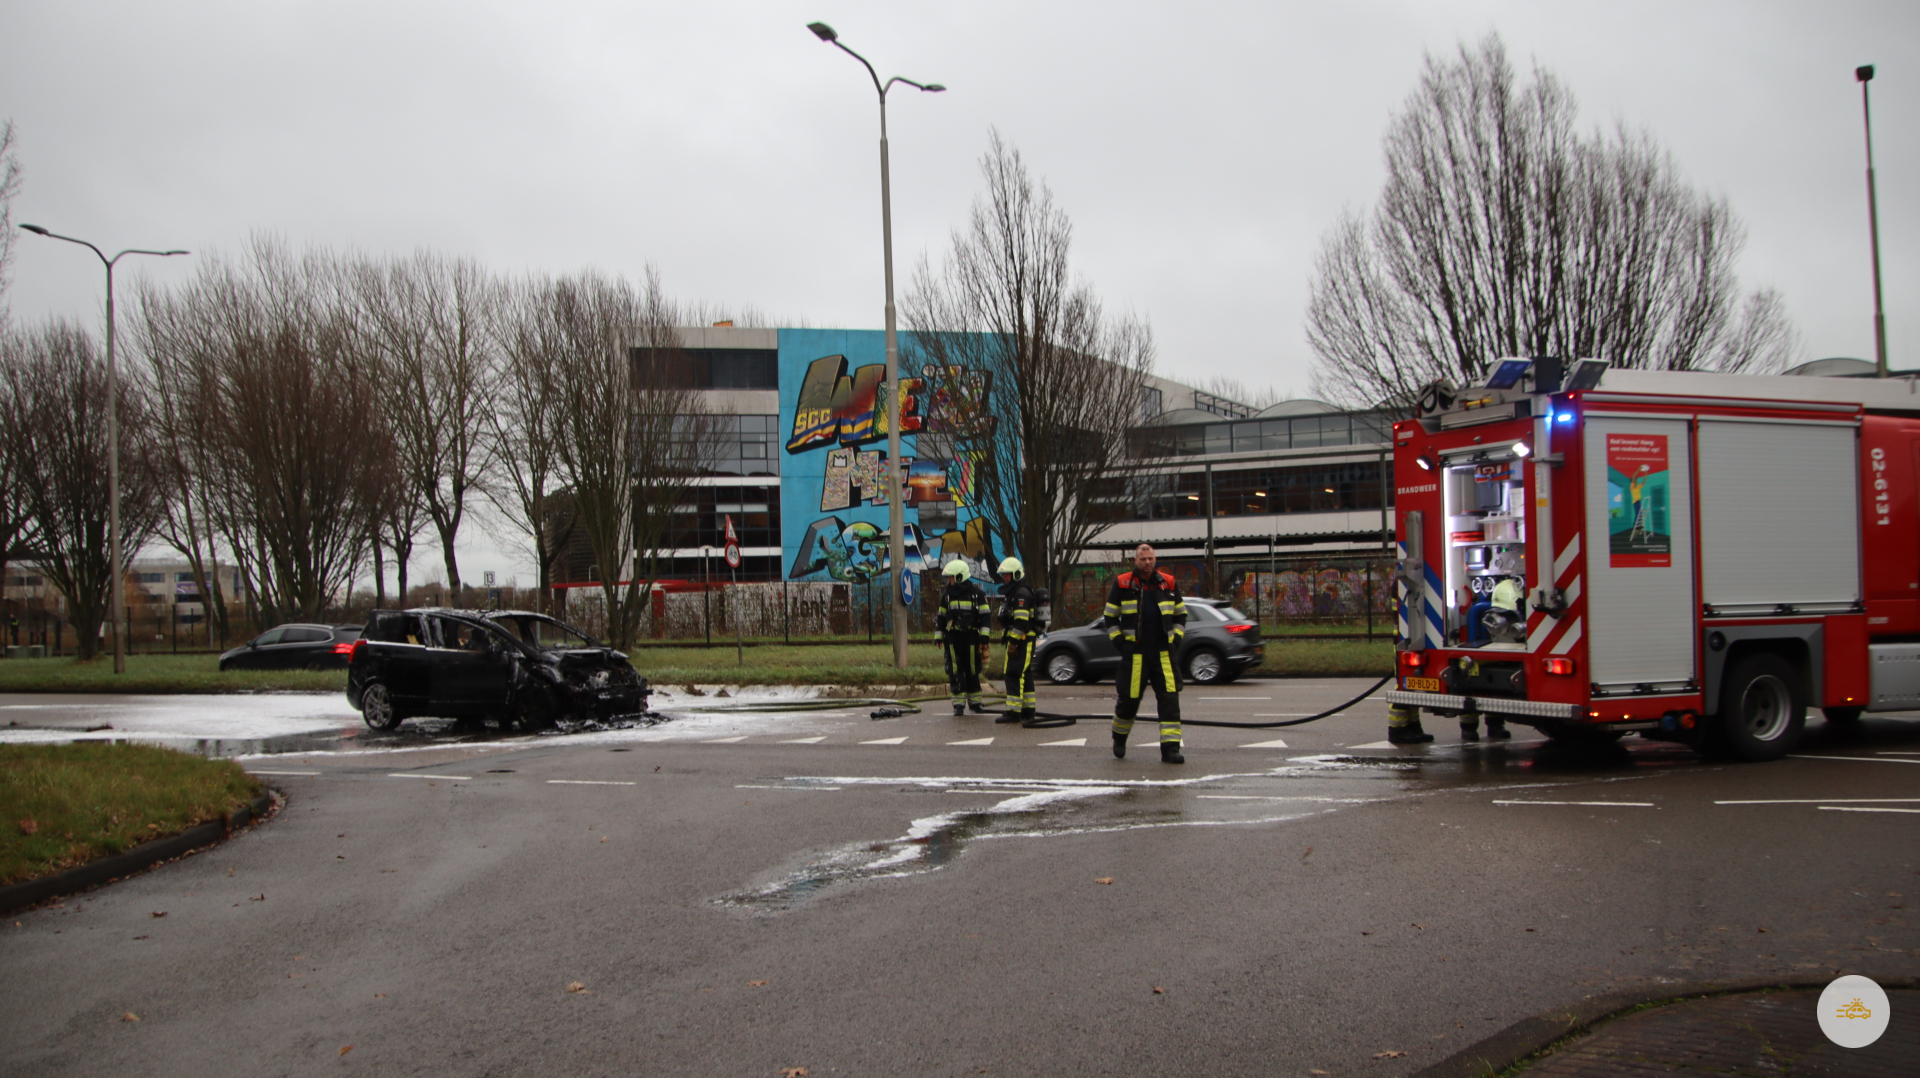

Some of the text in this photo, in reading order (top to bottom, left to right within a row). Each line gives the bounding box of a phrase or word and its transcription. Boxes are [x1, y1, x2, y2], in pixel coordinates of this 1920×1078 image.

[794, 408, 832, 436] SCC
[1397, 483, 1437, 495] BRANDWEER
[1871, 447, 1890, 526] 02-6131
[486, 573, 494, 584] 13
[1407, 678, 1437, 690] 30-BLD-2
